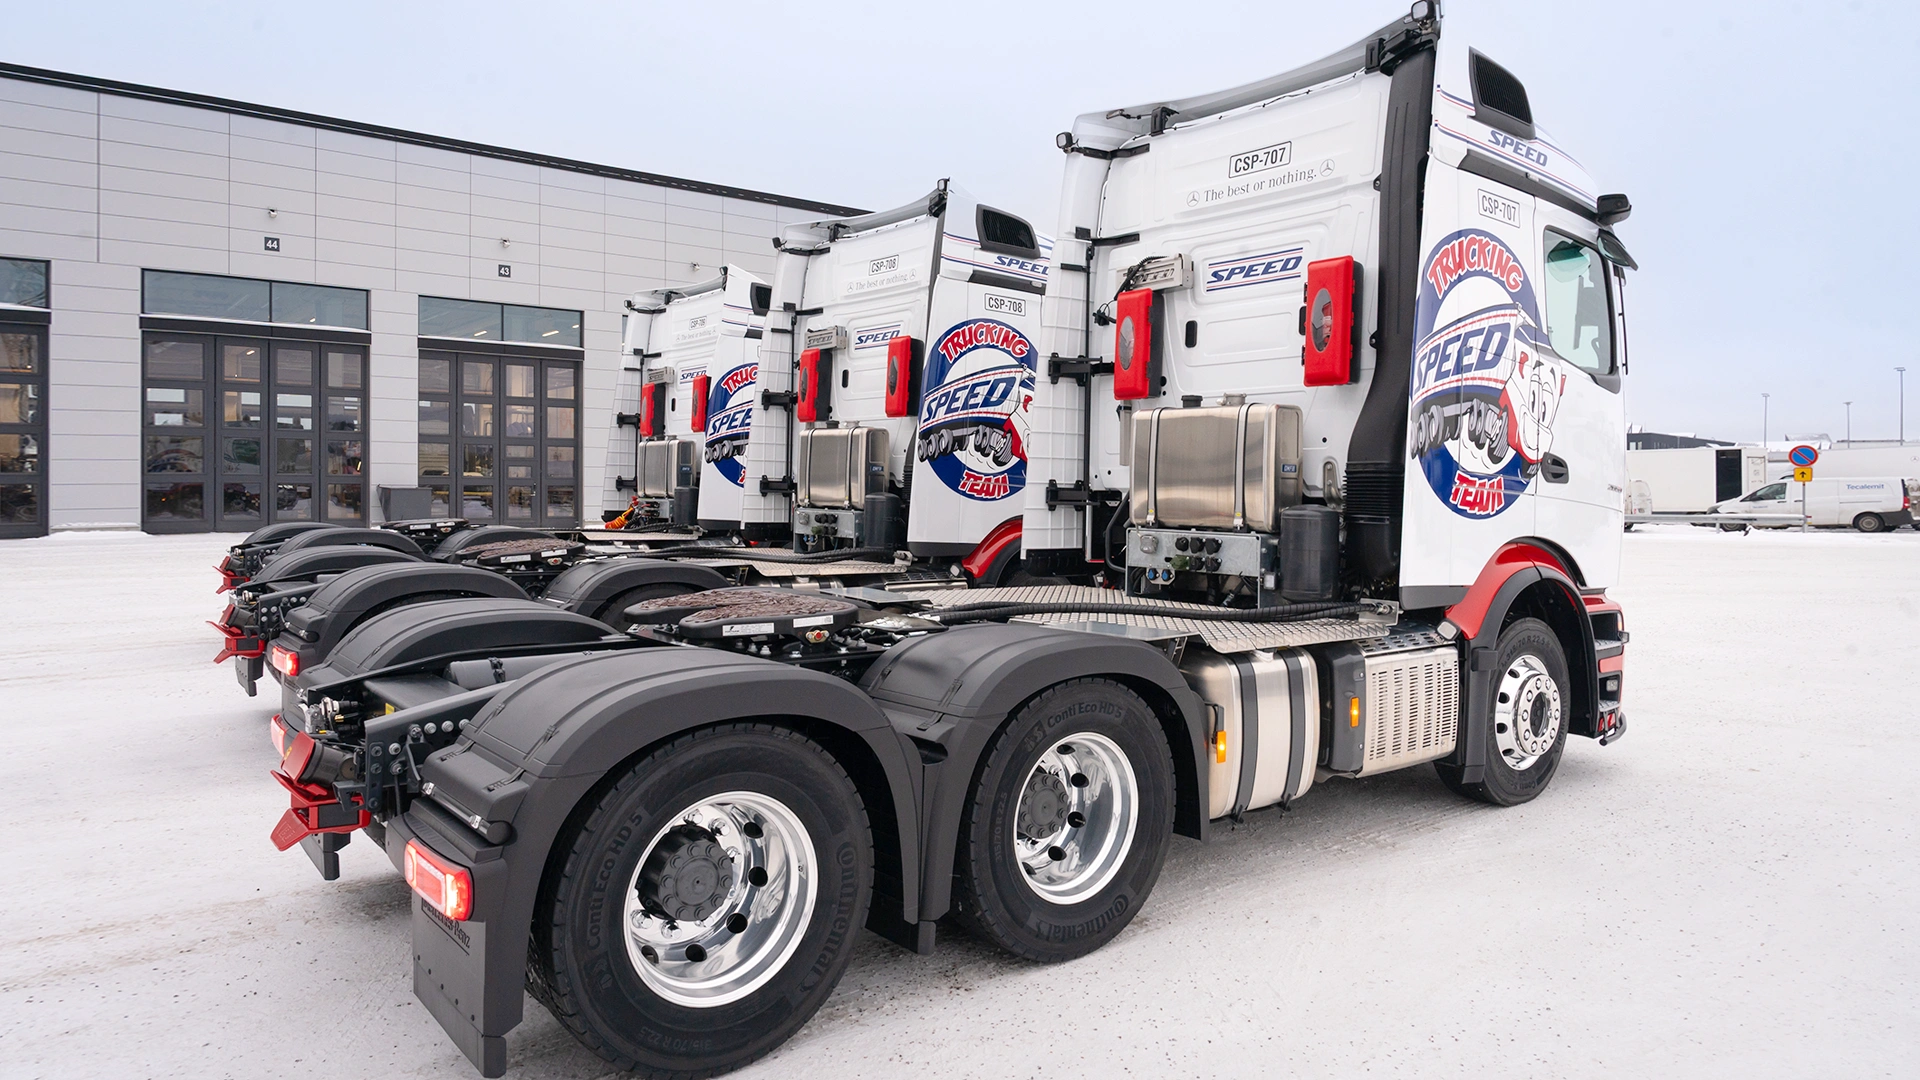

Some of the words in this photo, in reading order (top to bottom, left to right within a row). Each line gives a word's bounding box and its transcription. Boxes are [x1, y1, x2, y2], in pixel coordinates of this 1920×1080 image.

[1234, 147, 1286, 173] CSP-707
[1488, 130, 1548, 167] SPEED
[1204, 190, 1224, 202] The
[1227, 183, 1250, 197] best
[1253, 181, 1265, 191] or
[1268, 168, 1317, 188] nothing.
[1481, 195, 1516, 222] CSP-707
[266, 240, 278, 249] 44
[500, 267, 509, 275] 43
[871, 258, 897, 273] CSP-708
[1207, 256, 1303, 284] SPEED
[1427, 234, 1523, 299] TRUCKING
[855, 282, 865, 290] The
[866, 280, 879, 288] best
[988, 297, 1023, 313] CSP-708
[855, 330, 900, 345] SPEED
[939, 322, 1029, 363] TRUCKING
[1414, 322, 1511, 396] SPEED
[923, 377, 1016, 423] SPEED
[958, 470, 1010, 499] TEAM
[1449, 470, 1505, 515] TEAM
[1046, 704, 1077, 728] Conti
[1079, 702, 1098, 714] Eco
[594, 858, 616, 893] Eco
[811, 841, 858, 978] Continental
[1045, 894, 1129, 941] Continental
[586, 901, 603, 950] Conti
